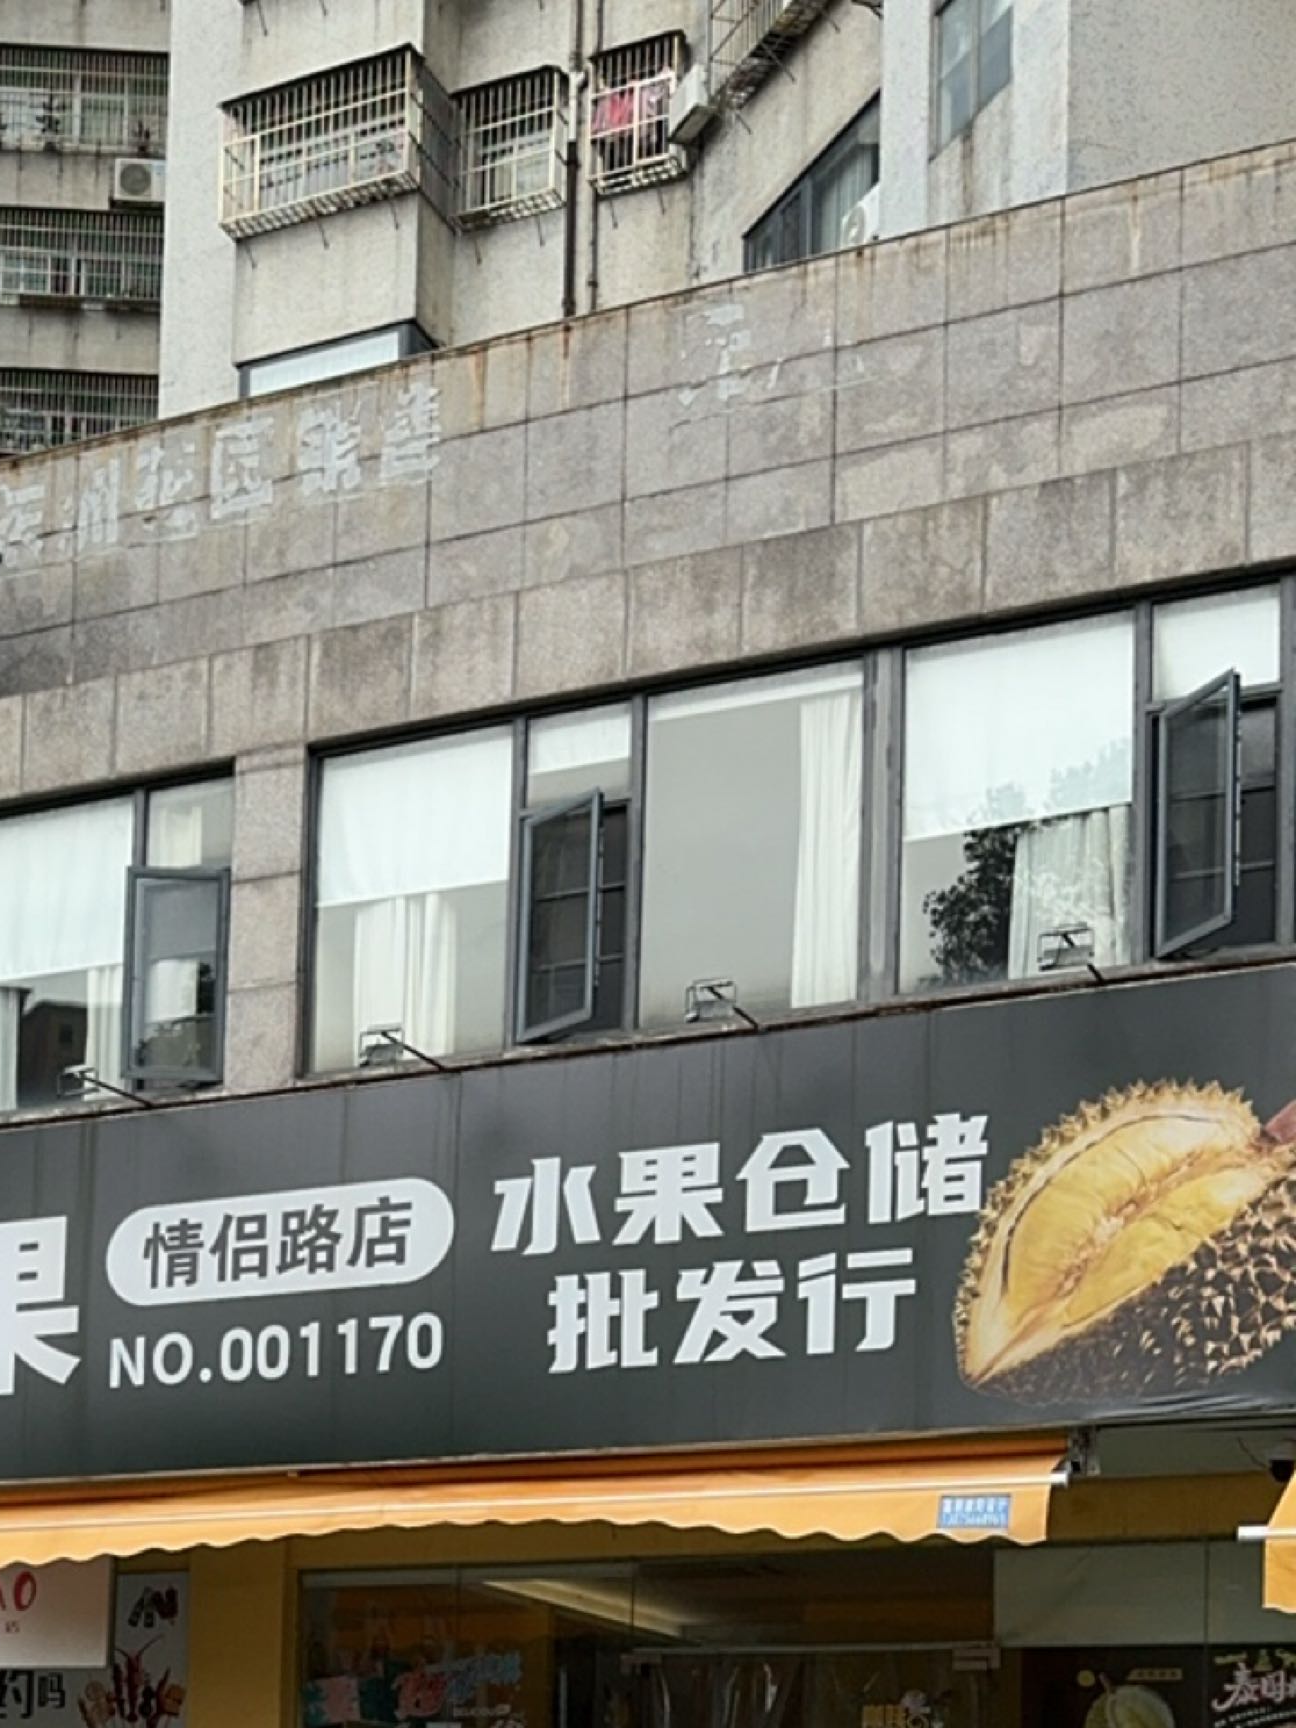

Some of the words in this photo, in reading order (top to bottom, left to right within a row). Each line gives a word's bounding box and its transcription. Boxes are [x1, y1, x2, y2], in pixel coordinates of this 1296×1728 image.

[490, 1112, 989, 1256] 水果仓储
[143, 1196, 415, 1290] 情侣路店
[109, 1312, 442, 1389] NO.001170
[547, 1247, 916, 1374] 批发行
